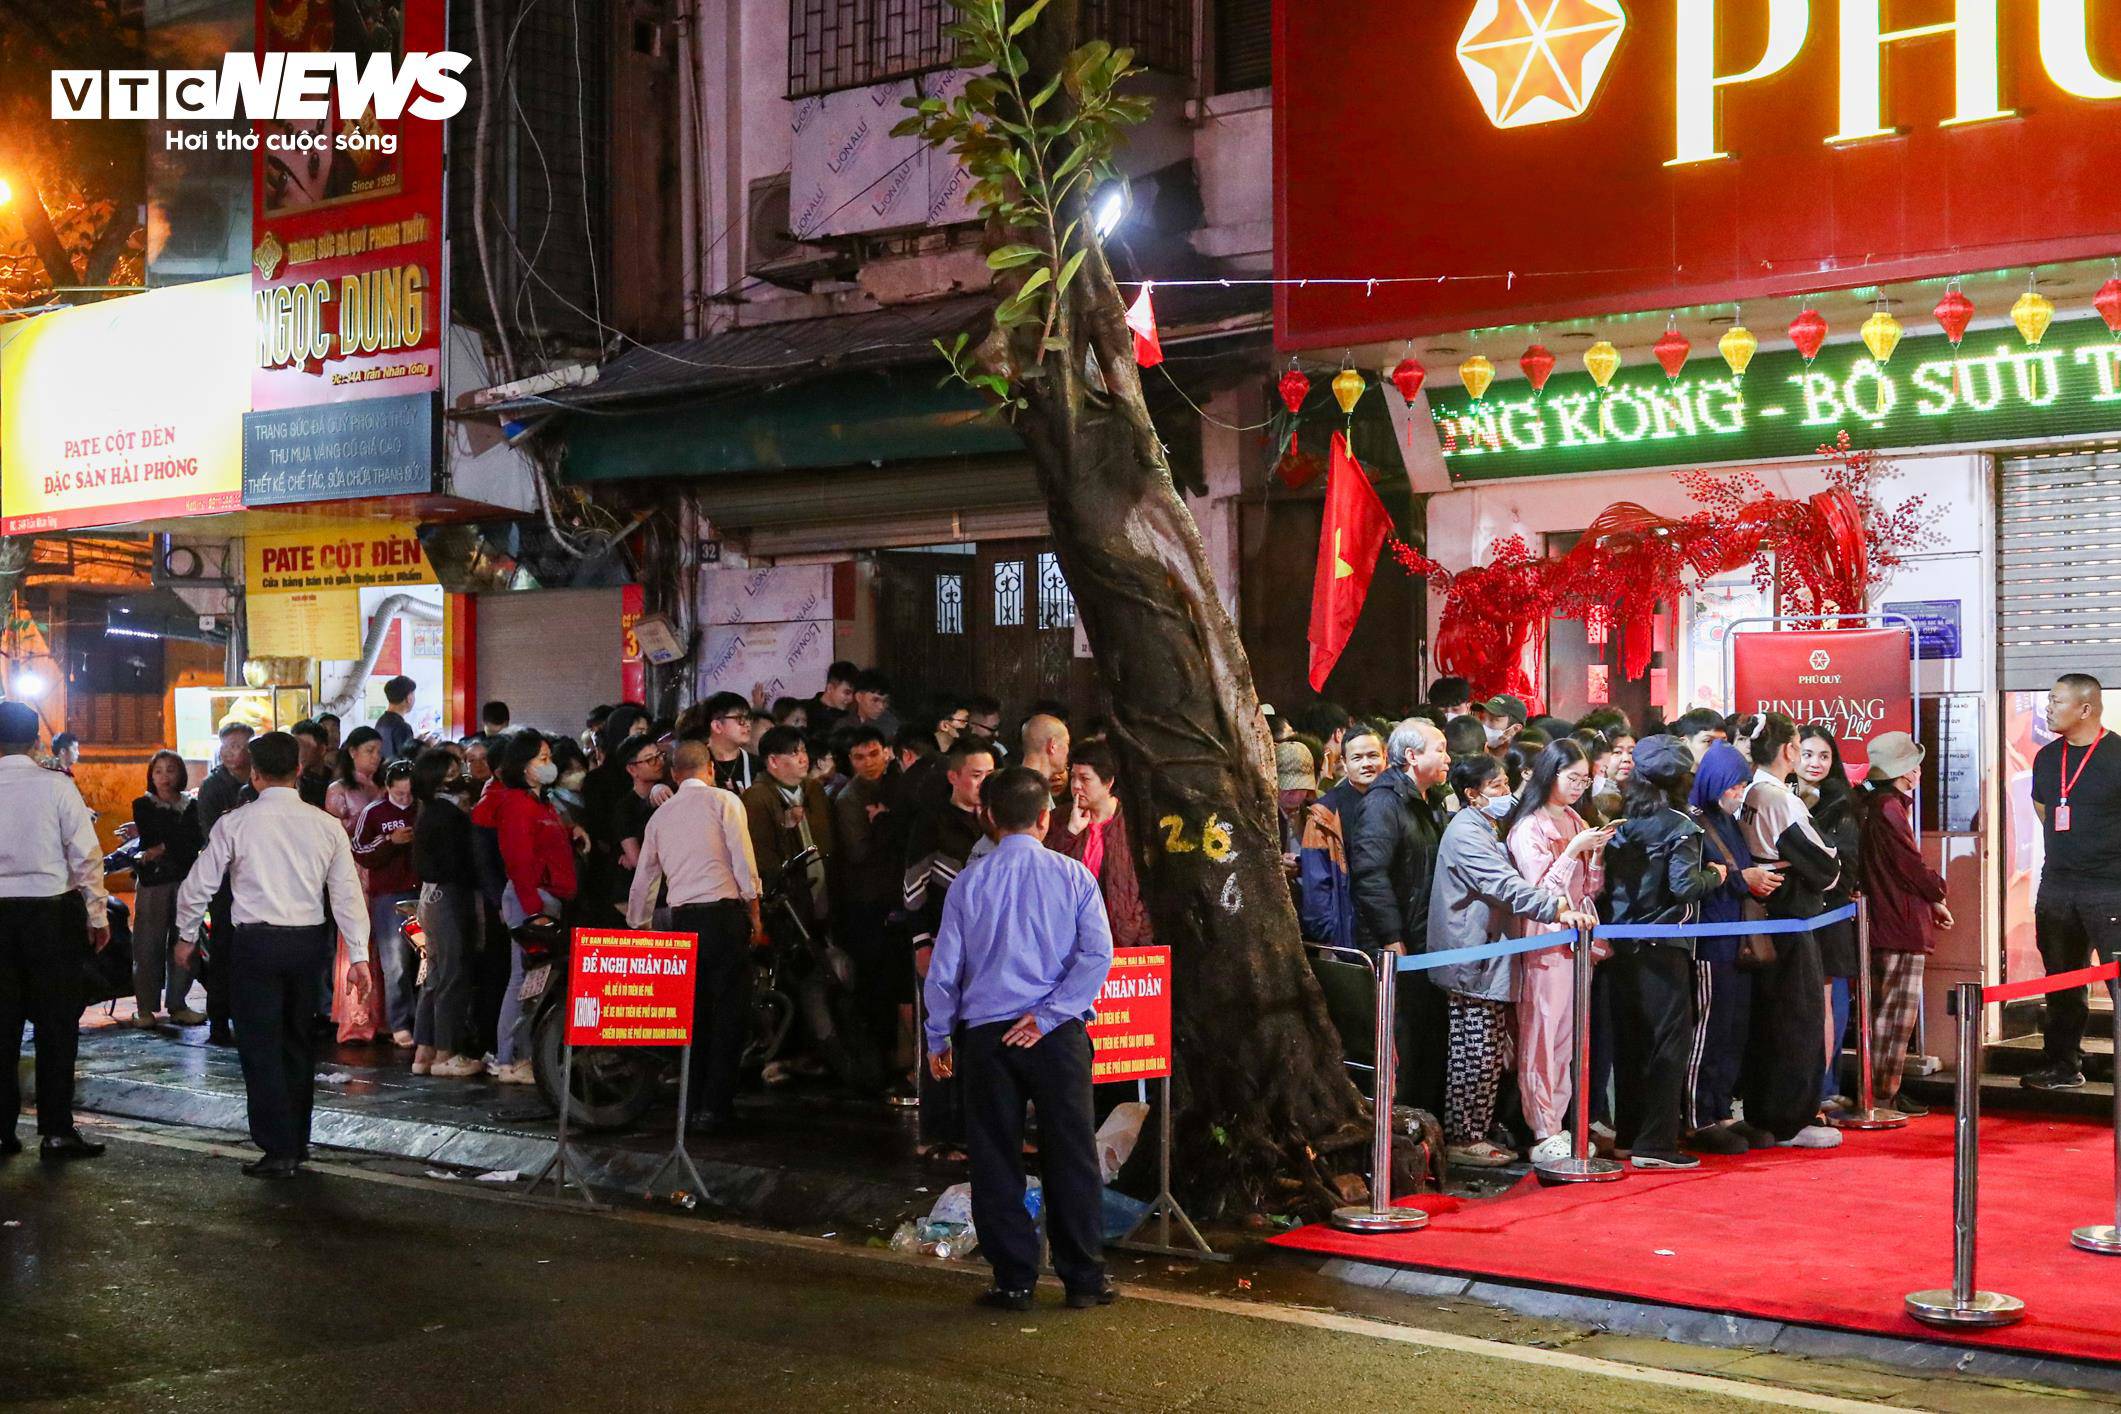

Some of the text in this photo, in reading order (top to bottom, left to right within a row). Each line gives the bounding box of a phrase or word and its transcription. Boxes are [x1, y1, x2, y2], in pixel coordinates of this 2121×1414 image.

[352, 174, 396, 192] Since 1989
[255, 263, 423, 372] NGỌC DUNG
[1786, 358, 1898, 429] BỘ
[1912, 346, 2063, 417] SƯU
[64, 424, 176, 458] PATE CỘT ĐÈN
[255, 423, 288, 441] TRANG
[270, 448, 289, 465] THU
[291, 446, 312, 464] MUA
[44, 469, 71, 496] ĐẶC
[143, 455, 198, 481] PHÒNG
[262, 534, 421, 574] PATE CỘT ĐÈN
[702, 543, 716, 559] 32
[626, 630, 638, 657] 3
[1799, 675, 1841, 684] PHÚ QUÝ
[1819, 695, 1886, 720] VÀNG
[1842, 714, 1873, 741] Lộc
[582, 948, 687, 977] ĐỀ NGHỊ NHÂN DÂN
[1104, 974, 1136, 999] NHÂN
[1138, 972, 1162, 997] DÂN
[574, 991, 597, 1028] KHÔNG
